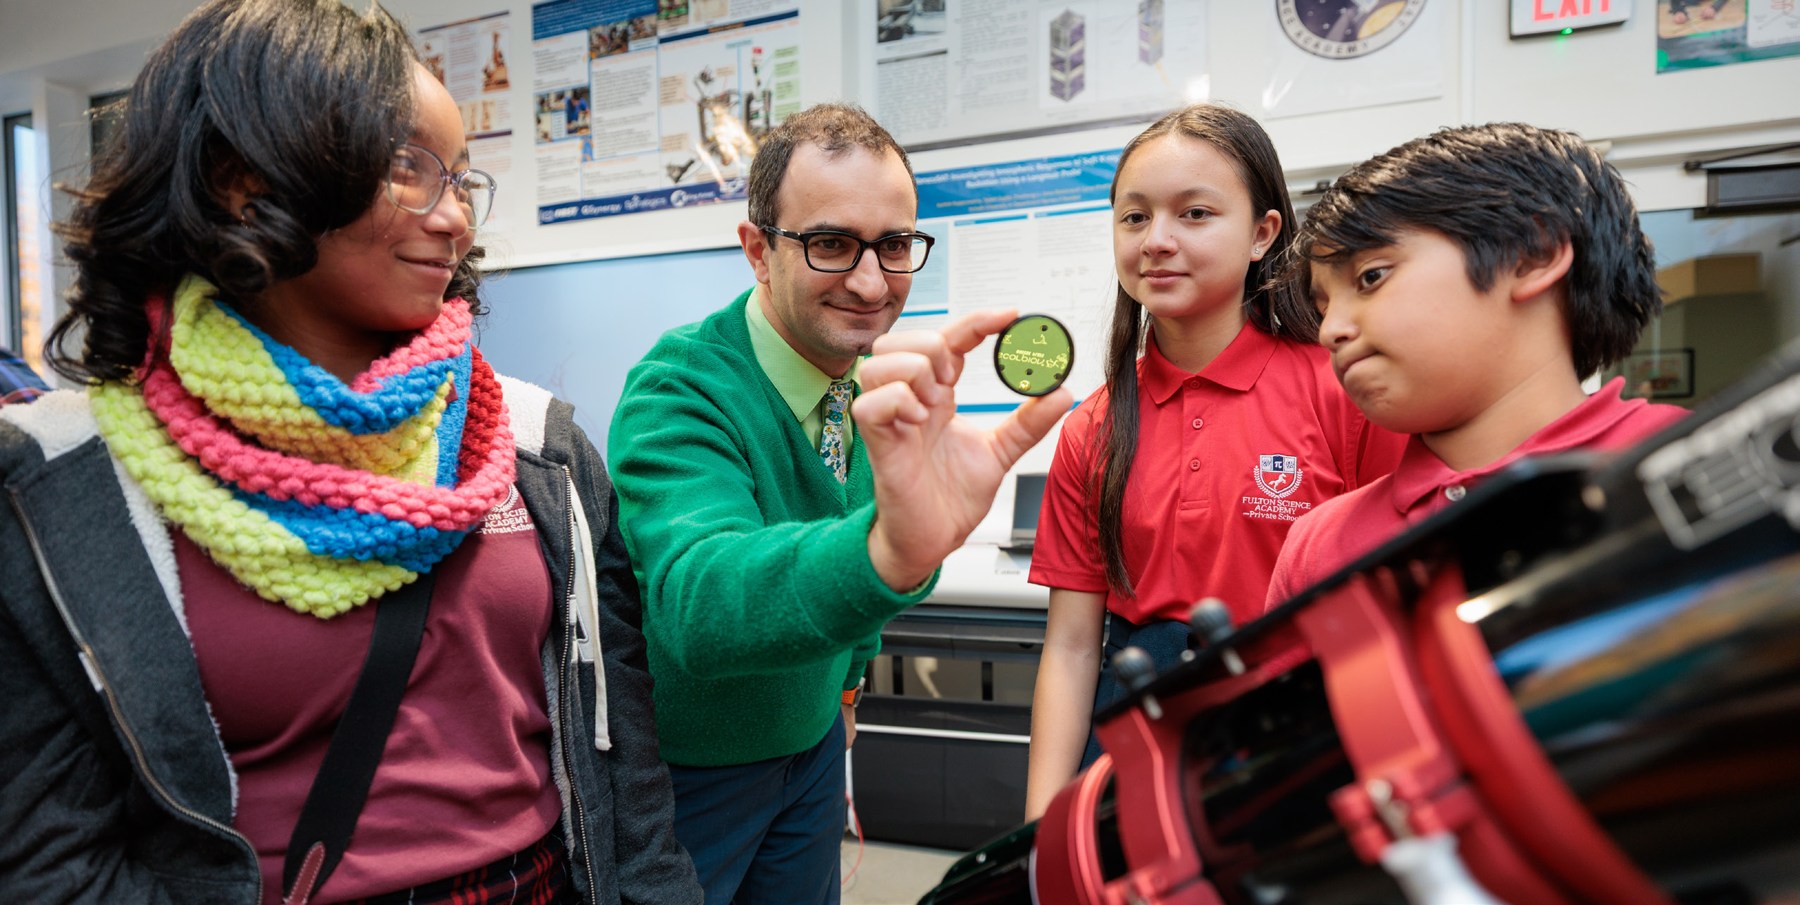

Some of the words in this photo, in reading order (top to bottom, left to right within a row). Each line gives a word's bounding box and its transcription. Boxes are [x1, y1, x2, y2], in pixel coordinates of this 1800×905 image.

[1242, 496, 1276, 506] FULTON
[1277, 499, 1311, 509] SCIENCE
[1254, 504, 1297, 515] ACADEMY
[485, 515, 528, 527] ACADEMY
[1278, 513, 1301, 522] Schoo
